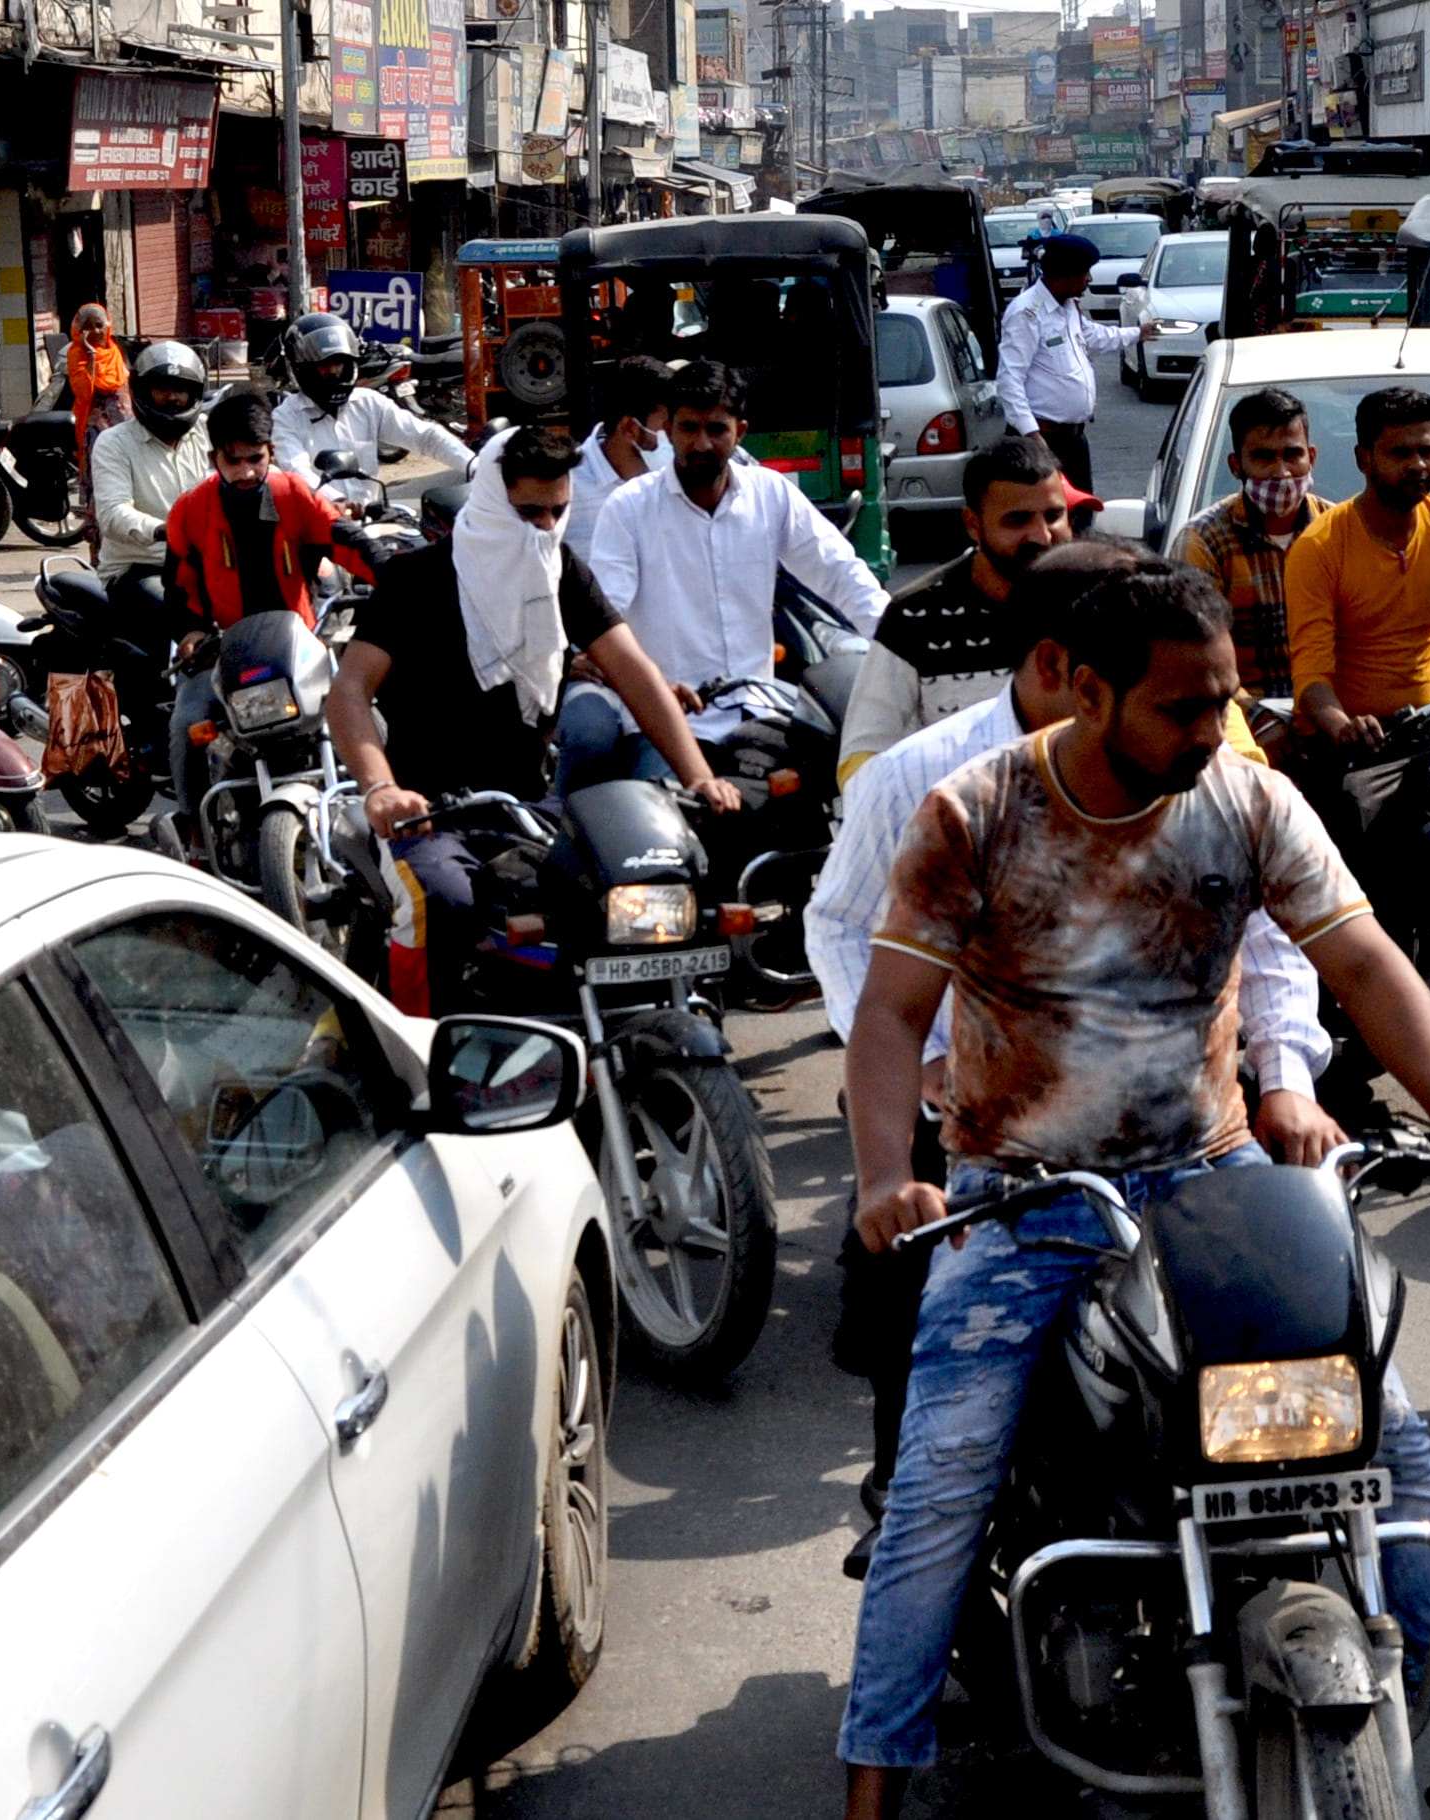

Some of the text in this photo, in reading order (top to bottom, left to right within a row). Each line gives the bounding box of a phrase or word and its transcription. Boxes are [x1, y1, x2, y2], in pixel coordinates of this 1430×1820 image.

[350, 143, 402, 170] शादी
[350, 170, 400, 198] कार्ड
[328, 276, 416, 330] शादी
